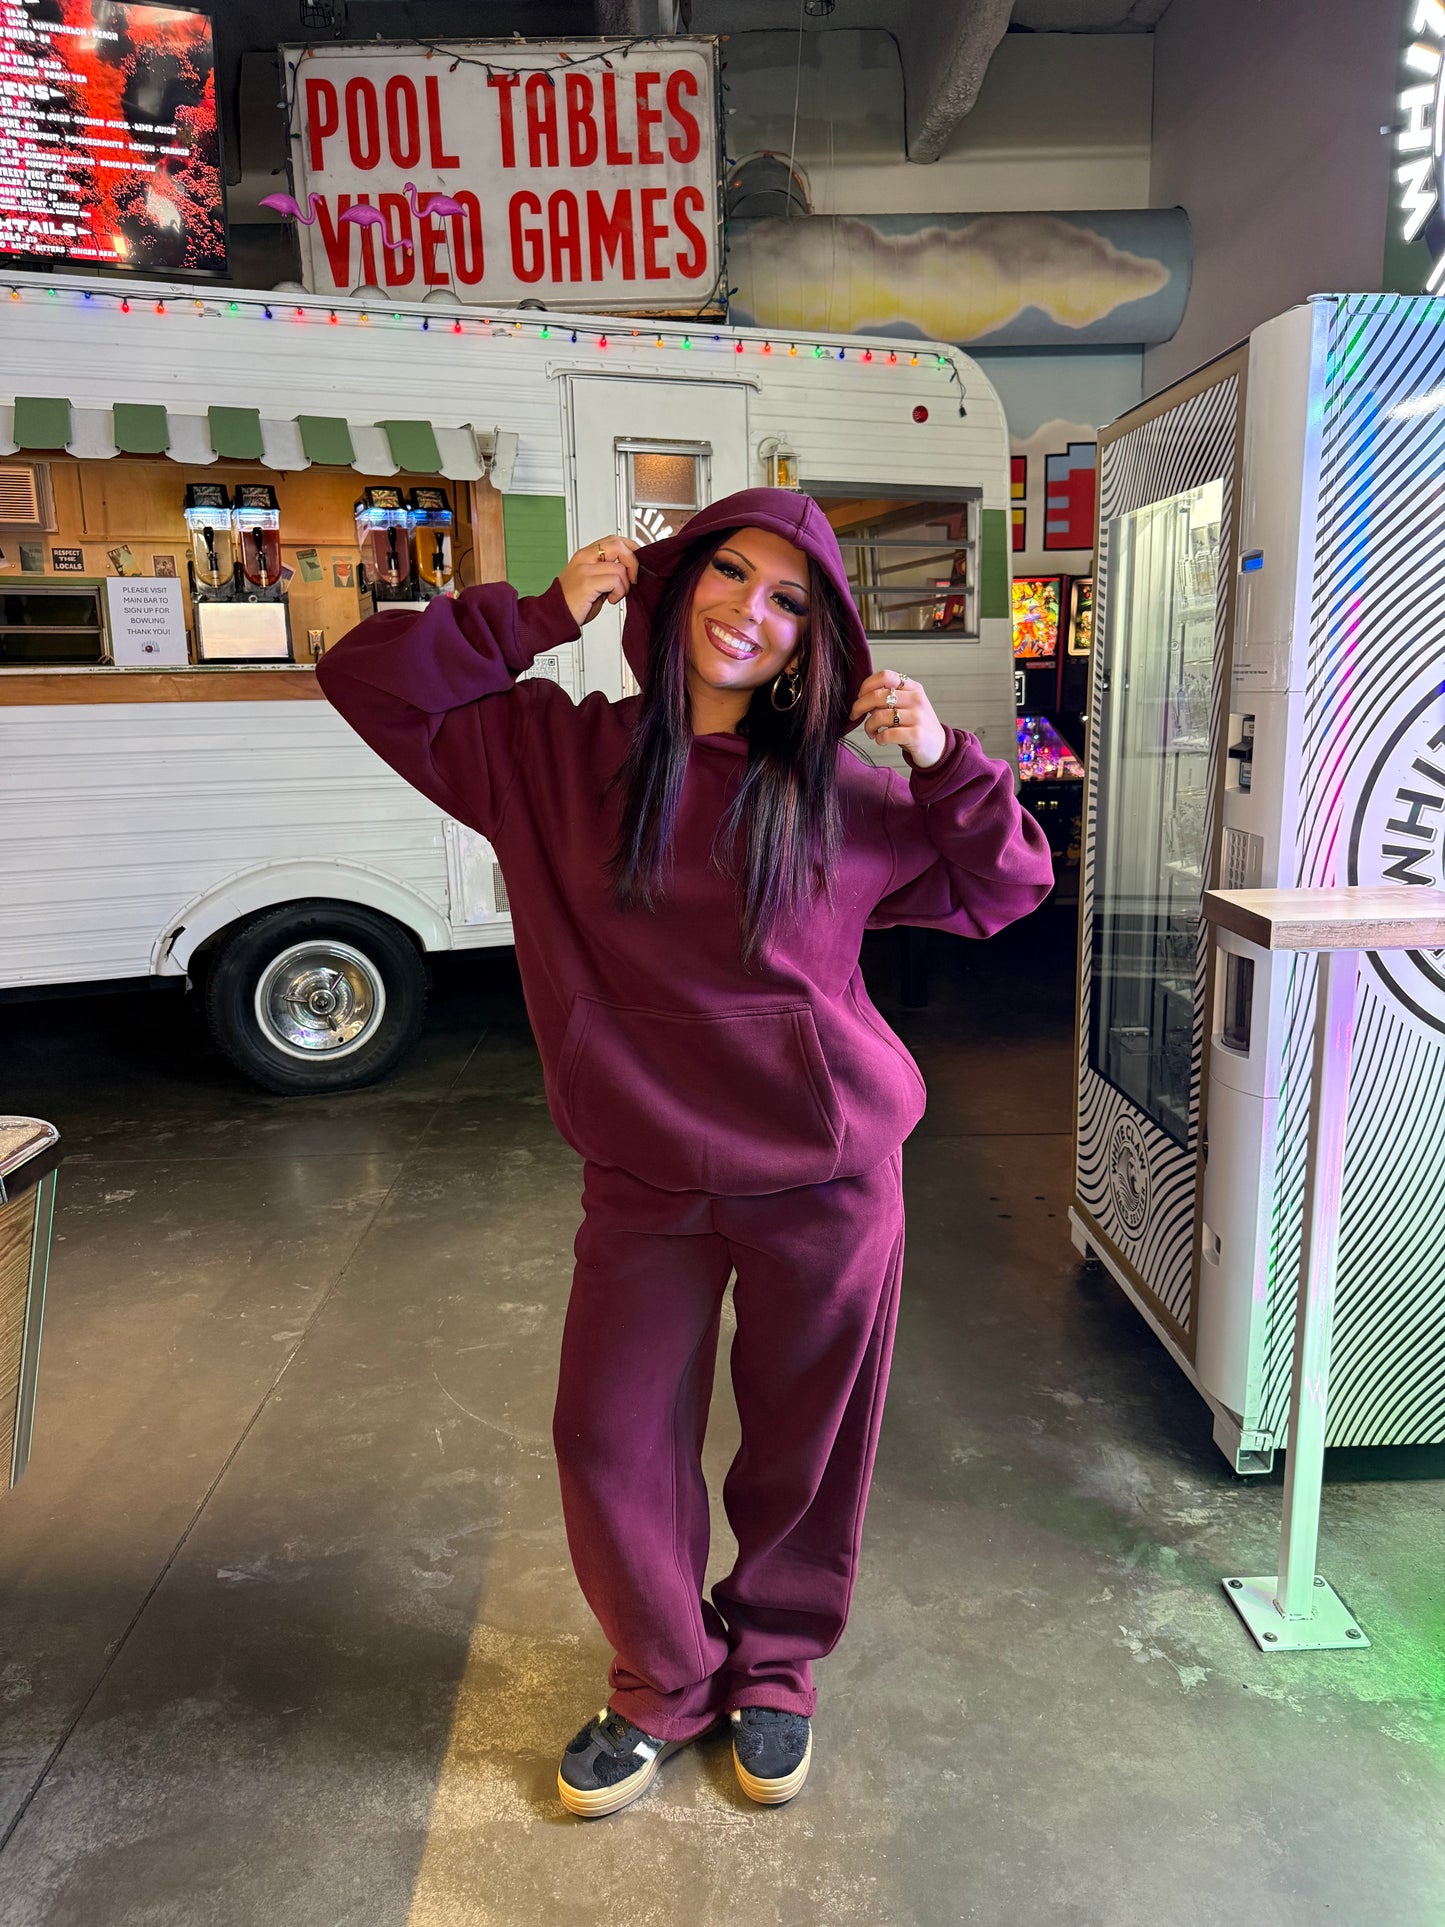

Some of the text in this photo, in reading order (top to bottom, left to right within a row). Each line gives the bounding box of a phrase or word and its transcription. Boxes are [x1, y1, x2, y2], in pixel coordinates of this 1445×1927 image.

[32, 20, 87, 37] WATERMELON
[92, 29, 118, 41] PEACH
[0, 65, 87, 83] EMONADE PEACH TEA
[2, 107, 46, 120] PINEAPPLE
[47, 113, 70, 122] JUICE
[74, 116, 105, 127] ORANGE
[154, 125, 177, 135] JUICE
[305, 69, 700, 172] POOL TABLES
[6, 128, 60, 142] PASSIONFRUIT
[128, 142, 155, 152] LEMON
[160, 146, 190, 156] ORANGE
[13, 150, 61, 162] BLACKBERRY
[100, 160, 131, 170] BANANA
[132, 163, 156, 172] PUREE
[26, 160, 67, 171] PINEAPPLE
[31, 180, 47, 189] RUM
[49, 182, 80, 191] RUNNER
[21, 199, 47, 207] HONEY
[53, 202, 80, 210] MANGO
[319, 186, 707, 289] VIDEO GAMES
[11, 242, 30, 250] LIME
[36, 245, 65, 253] BITTERS
[71, 248, 97, 256] GINGER
[99, 250, 118, 258] BEER
[55, 562, 83, 570] LOCALS
[122, 586, 168, 594] PLEASE VISIT
[123, 596, 142, 604] MAIN
[1111, 1124, 1147, 1174] WHITE CLAW
